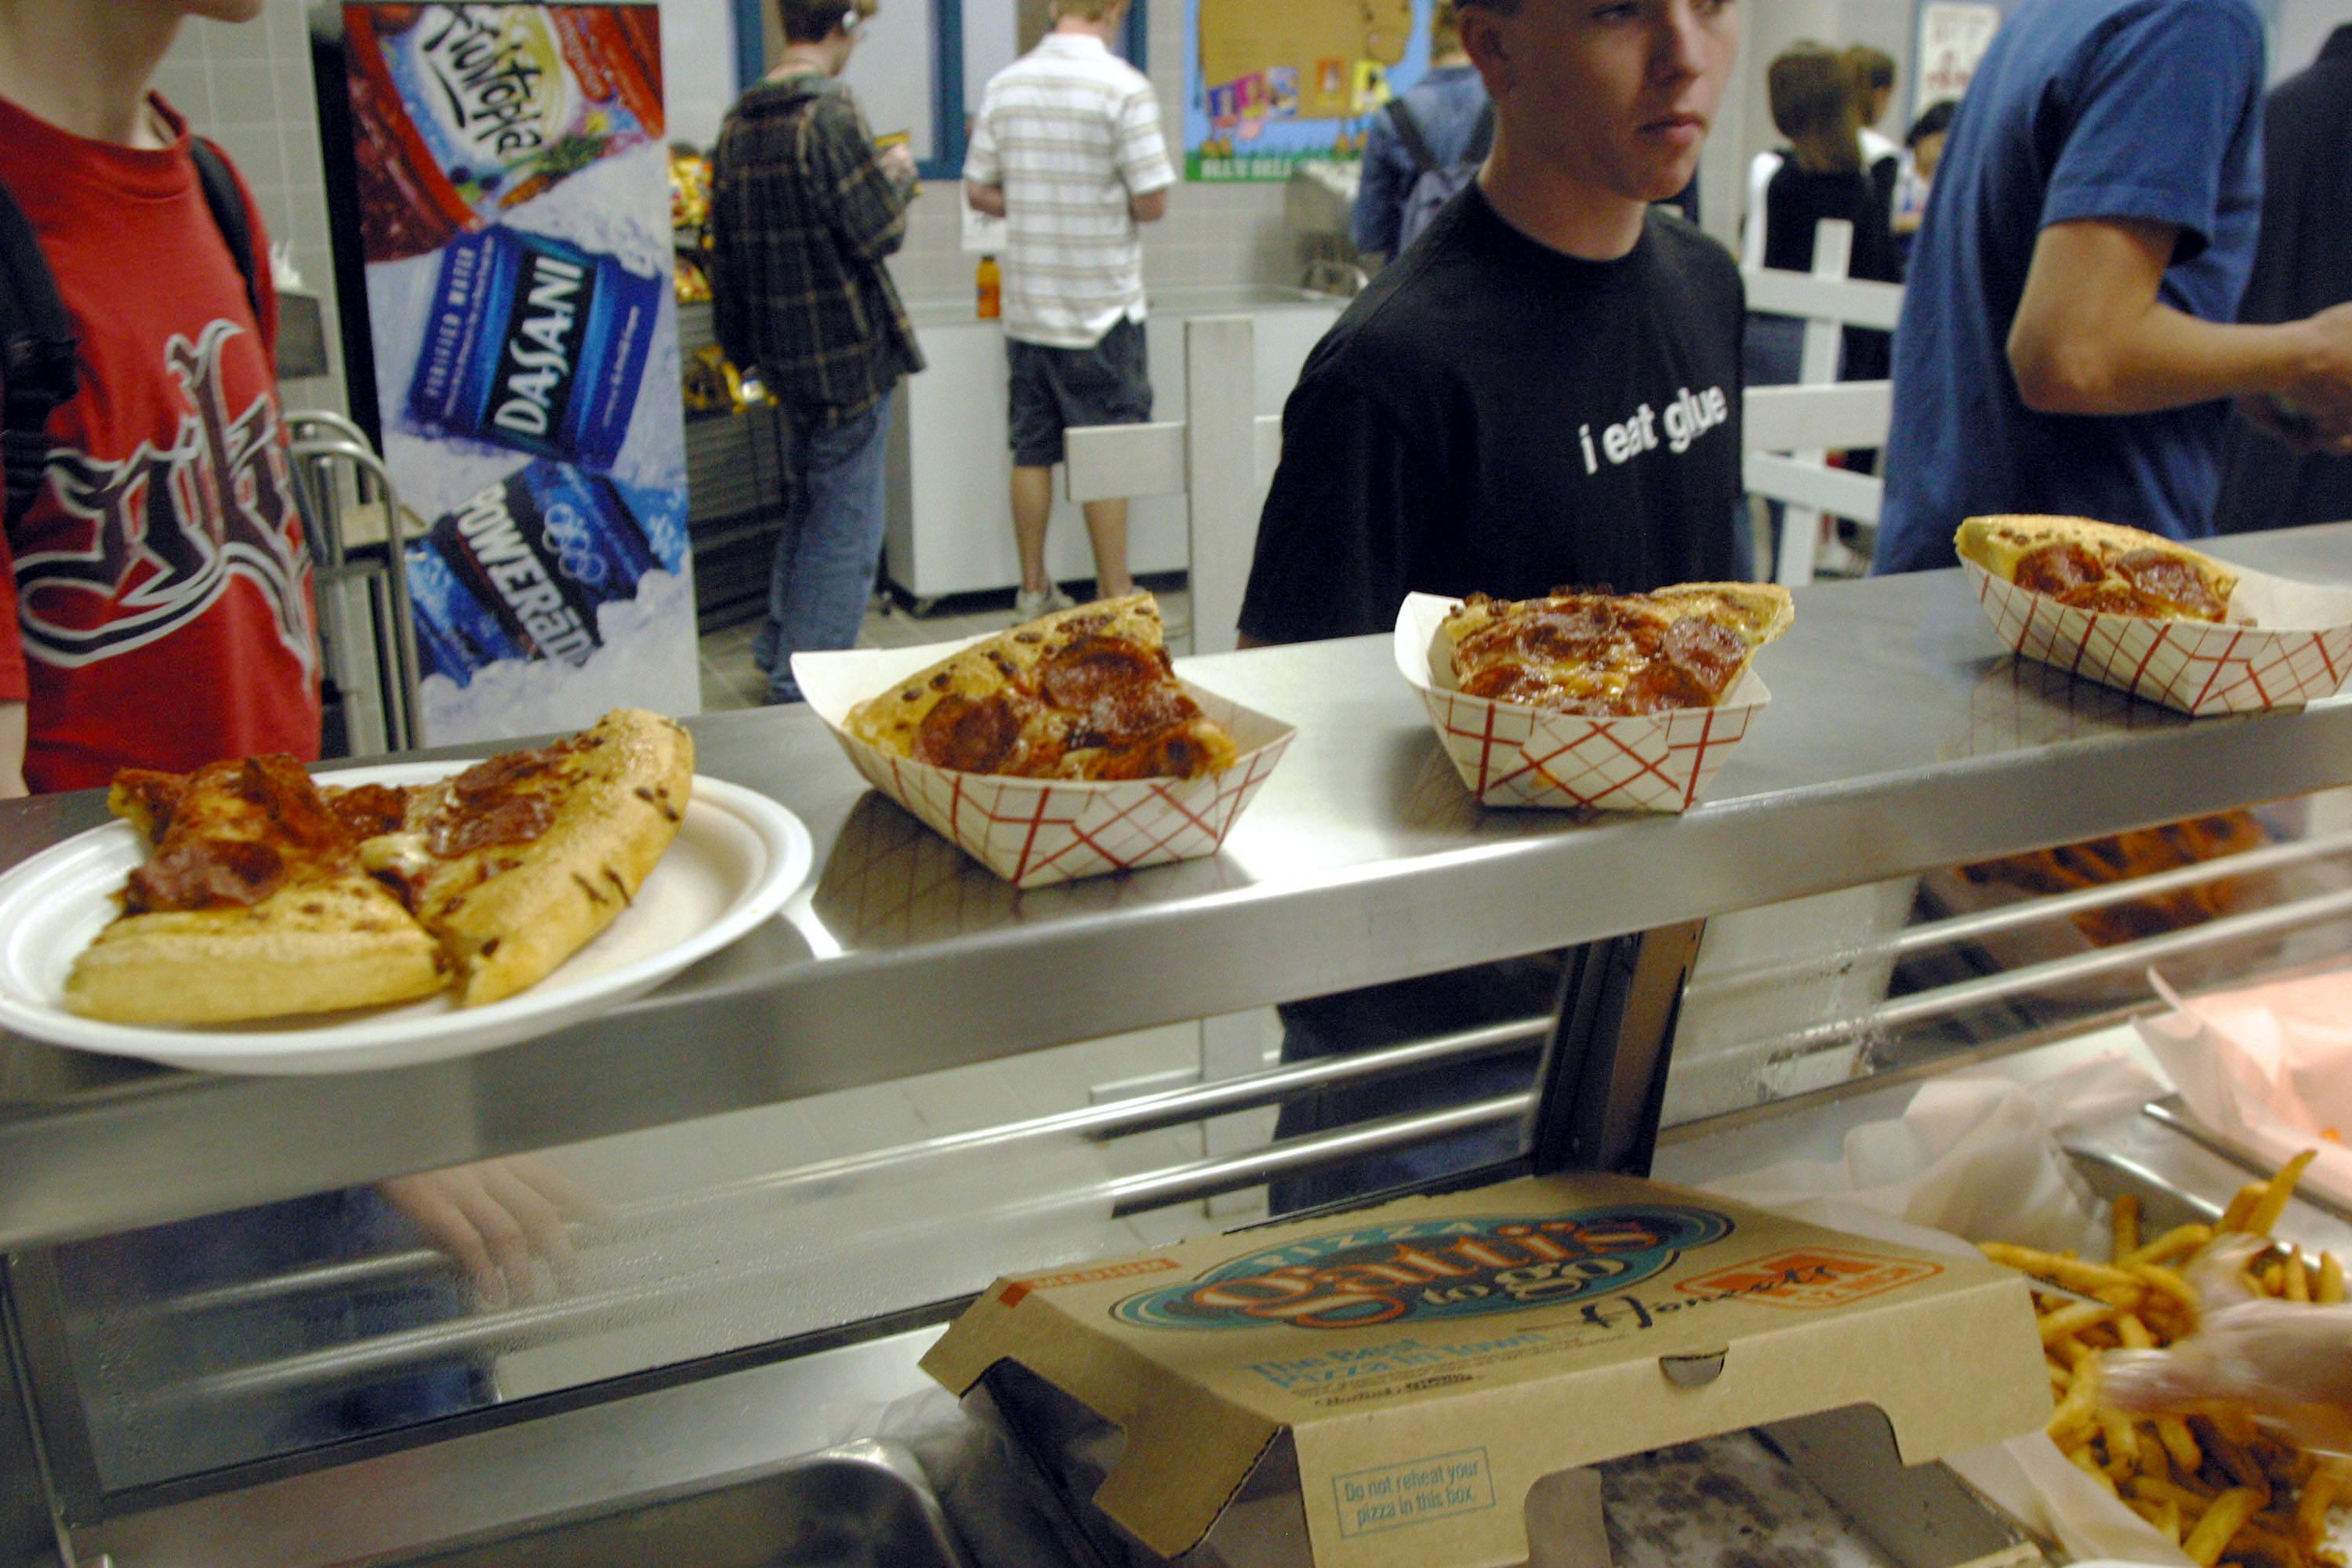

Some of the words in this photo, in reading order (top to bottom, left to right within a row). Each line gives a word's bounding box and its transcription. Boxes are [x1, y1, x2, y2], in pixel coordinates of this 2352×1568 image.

[494, 256, 585, 436] DASANI
[1578, 423, 1599, 475] i
[1602, 403, 1659, 464] eat
[1664, 385, 1728, 454] glue
[1254, 1220, 1479, 1267] PIZZA
[1422, 1283, 1490, 1305] to
[1494, 1258, 1627, 1301] go
[1344, 1481, 1365, 1502] Do
[1369, 1476, 1392, 1497] not
[1396, 1465, 1445, 1490] reheat
[1446, 1460, 1479, 1485] your
[1356, 1503, 1396, 1527] pizza
[1399, 1495, 1413, 1515] in
[1416, 1490, 1443, 1512] this
